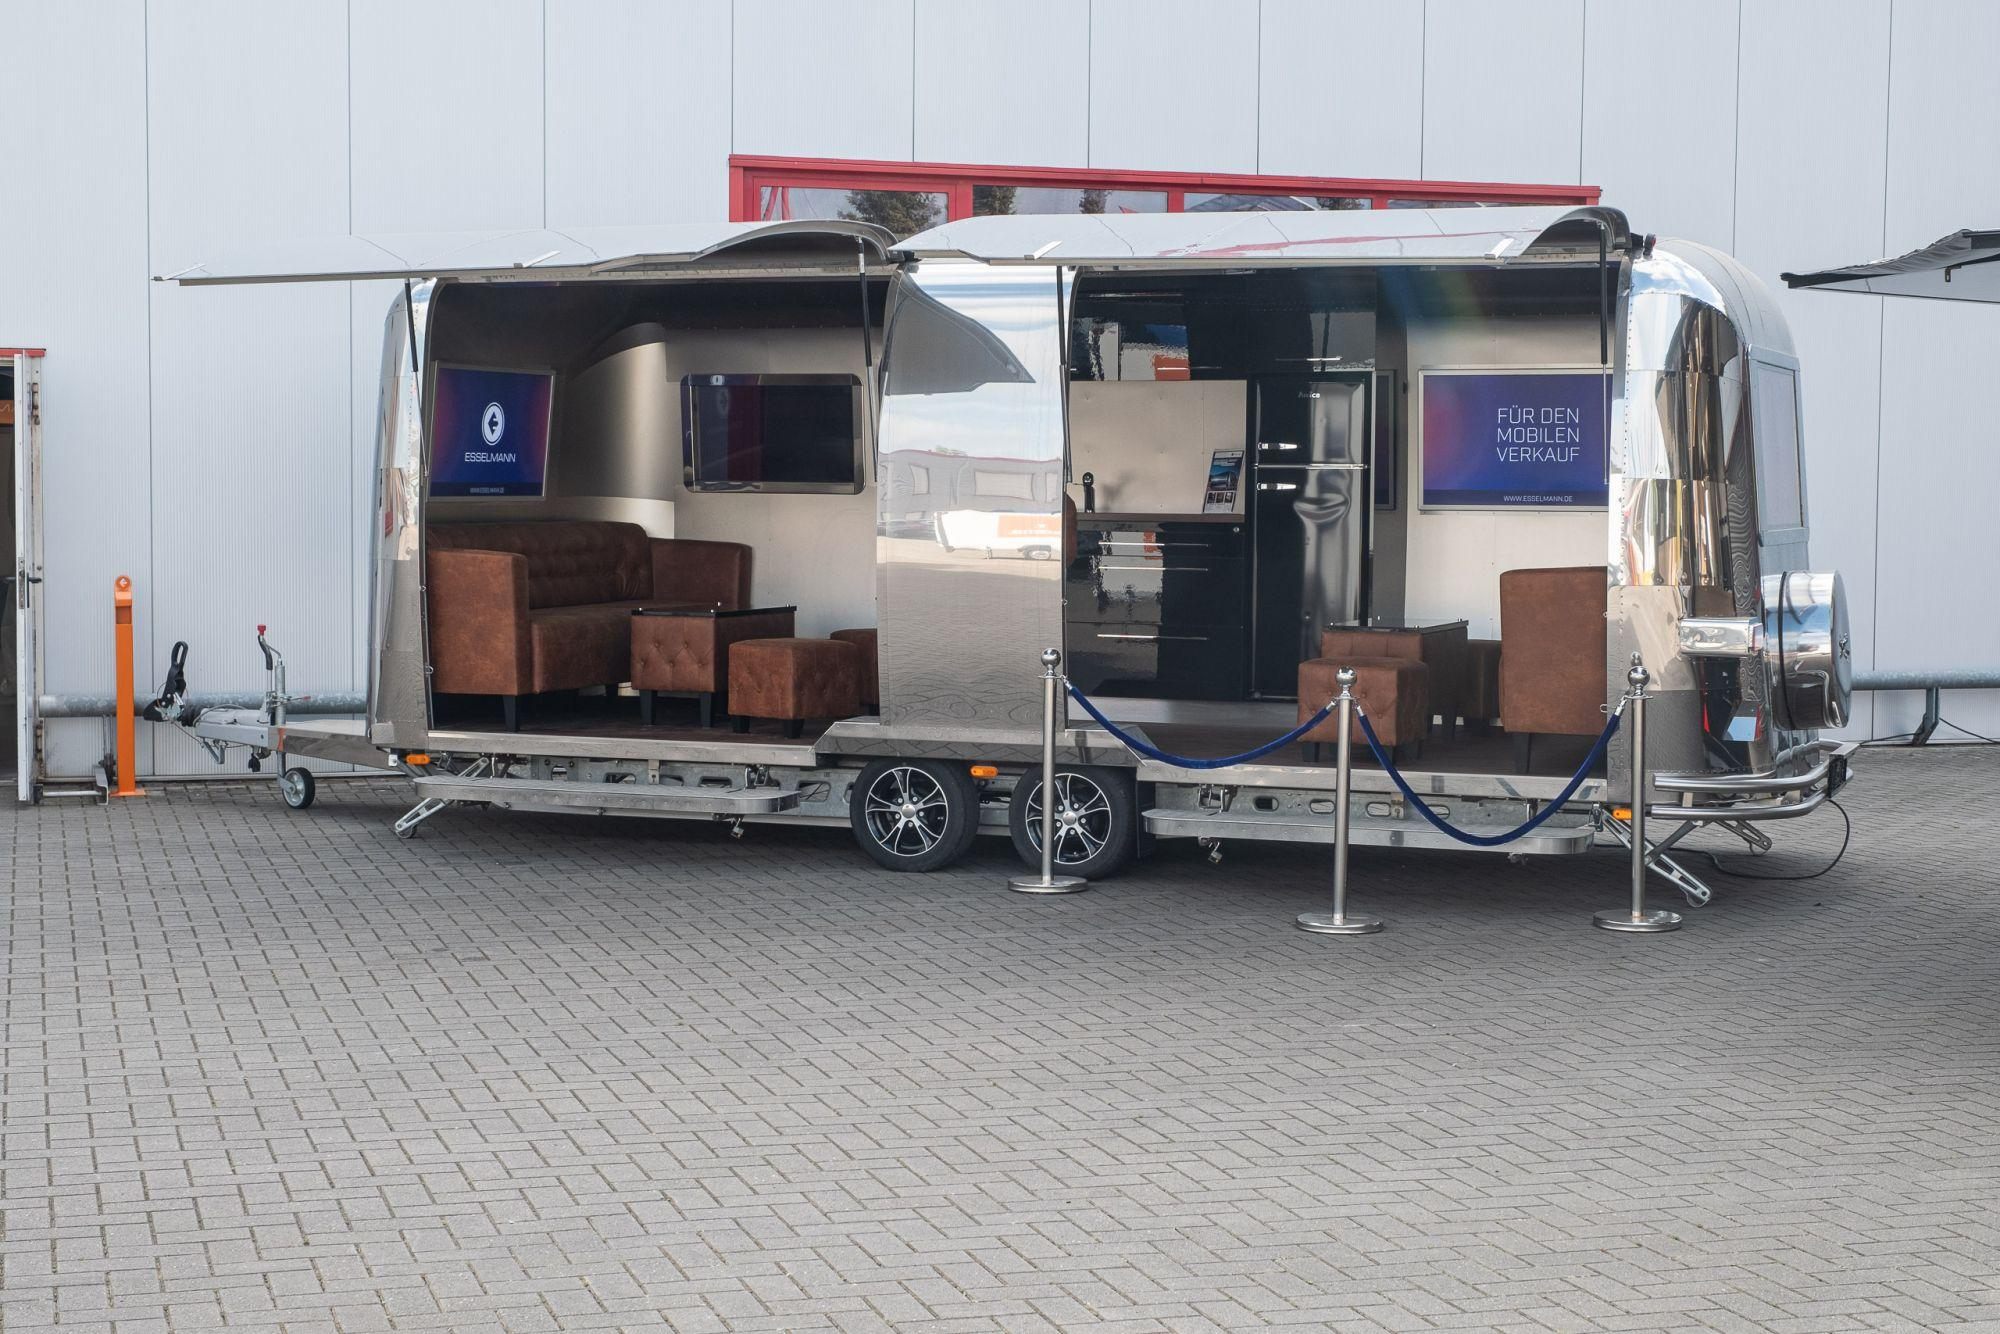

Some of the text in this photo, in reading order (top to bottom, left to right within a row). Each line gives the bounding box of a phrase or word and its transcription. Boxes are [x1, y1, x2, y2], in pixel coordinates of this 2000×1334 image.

[1498, 405, 1579, 424] FÜR DEN
[1497, 428, 1580, 443] MOBILEN
[465, 452, 516, 462] ESSELMANN
[1496, 447, 1580, 462] VERKAUF
